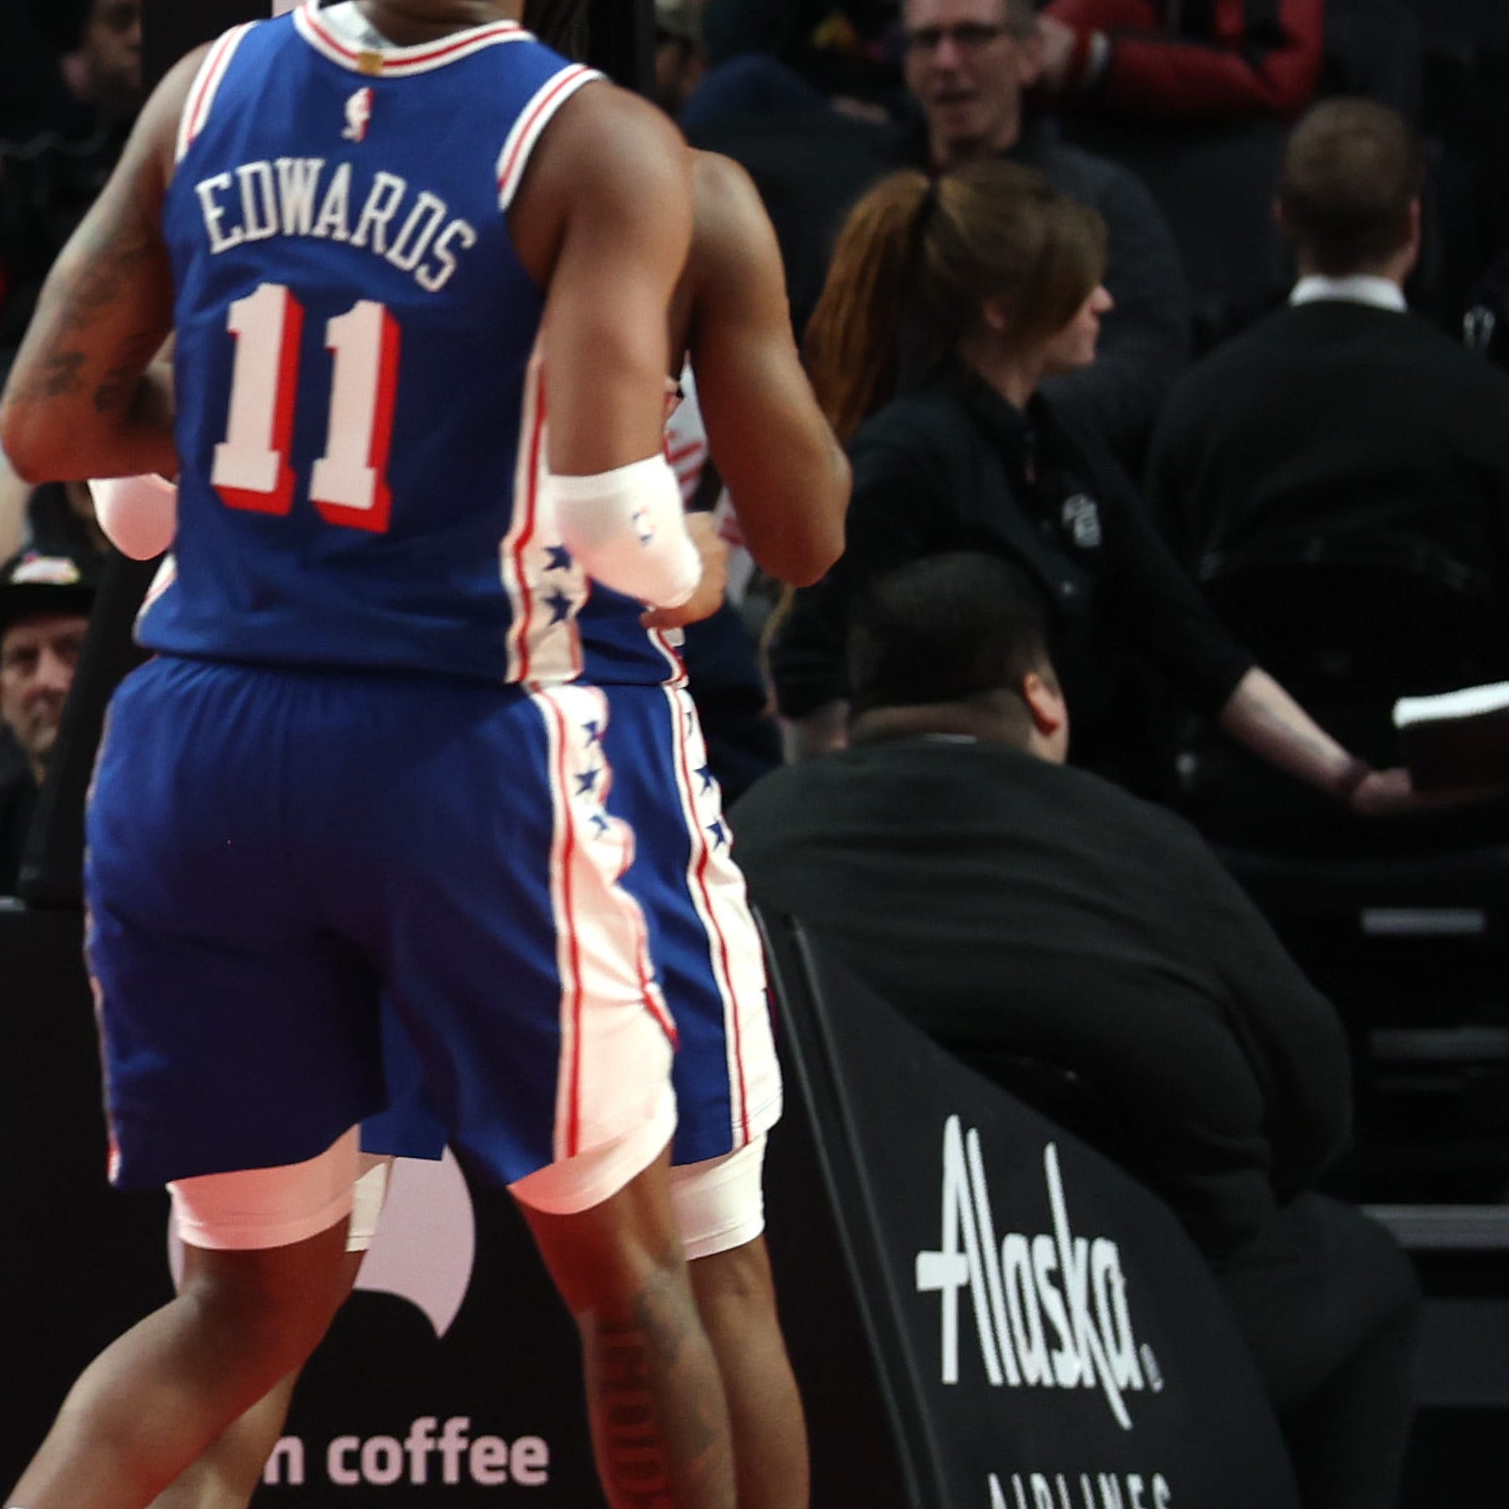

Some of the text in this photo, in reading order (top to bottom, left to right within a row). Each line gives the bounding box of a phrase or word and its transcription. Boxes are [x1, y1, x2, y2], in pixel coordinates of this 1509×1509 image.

[195, 157, 478, 293] EDWARDS
[210, 282, 405, 535] 11
[916, 1113, 1147, 1431] Alaska
[326, 1416, 550, 1486] coffee
